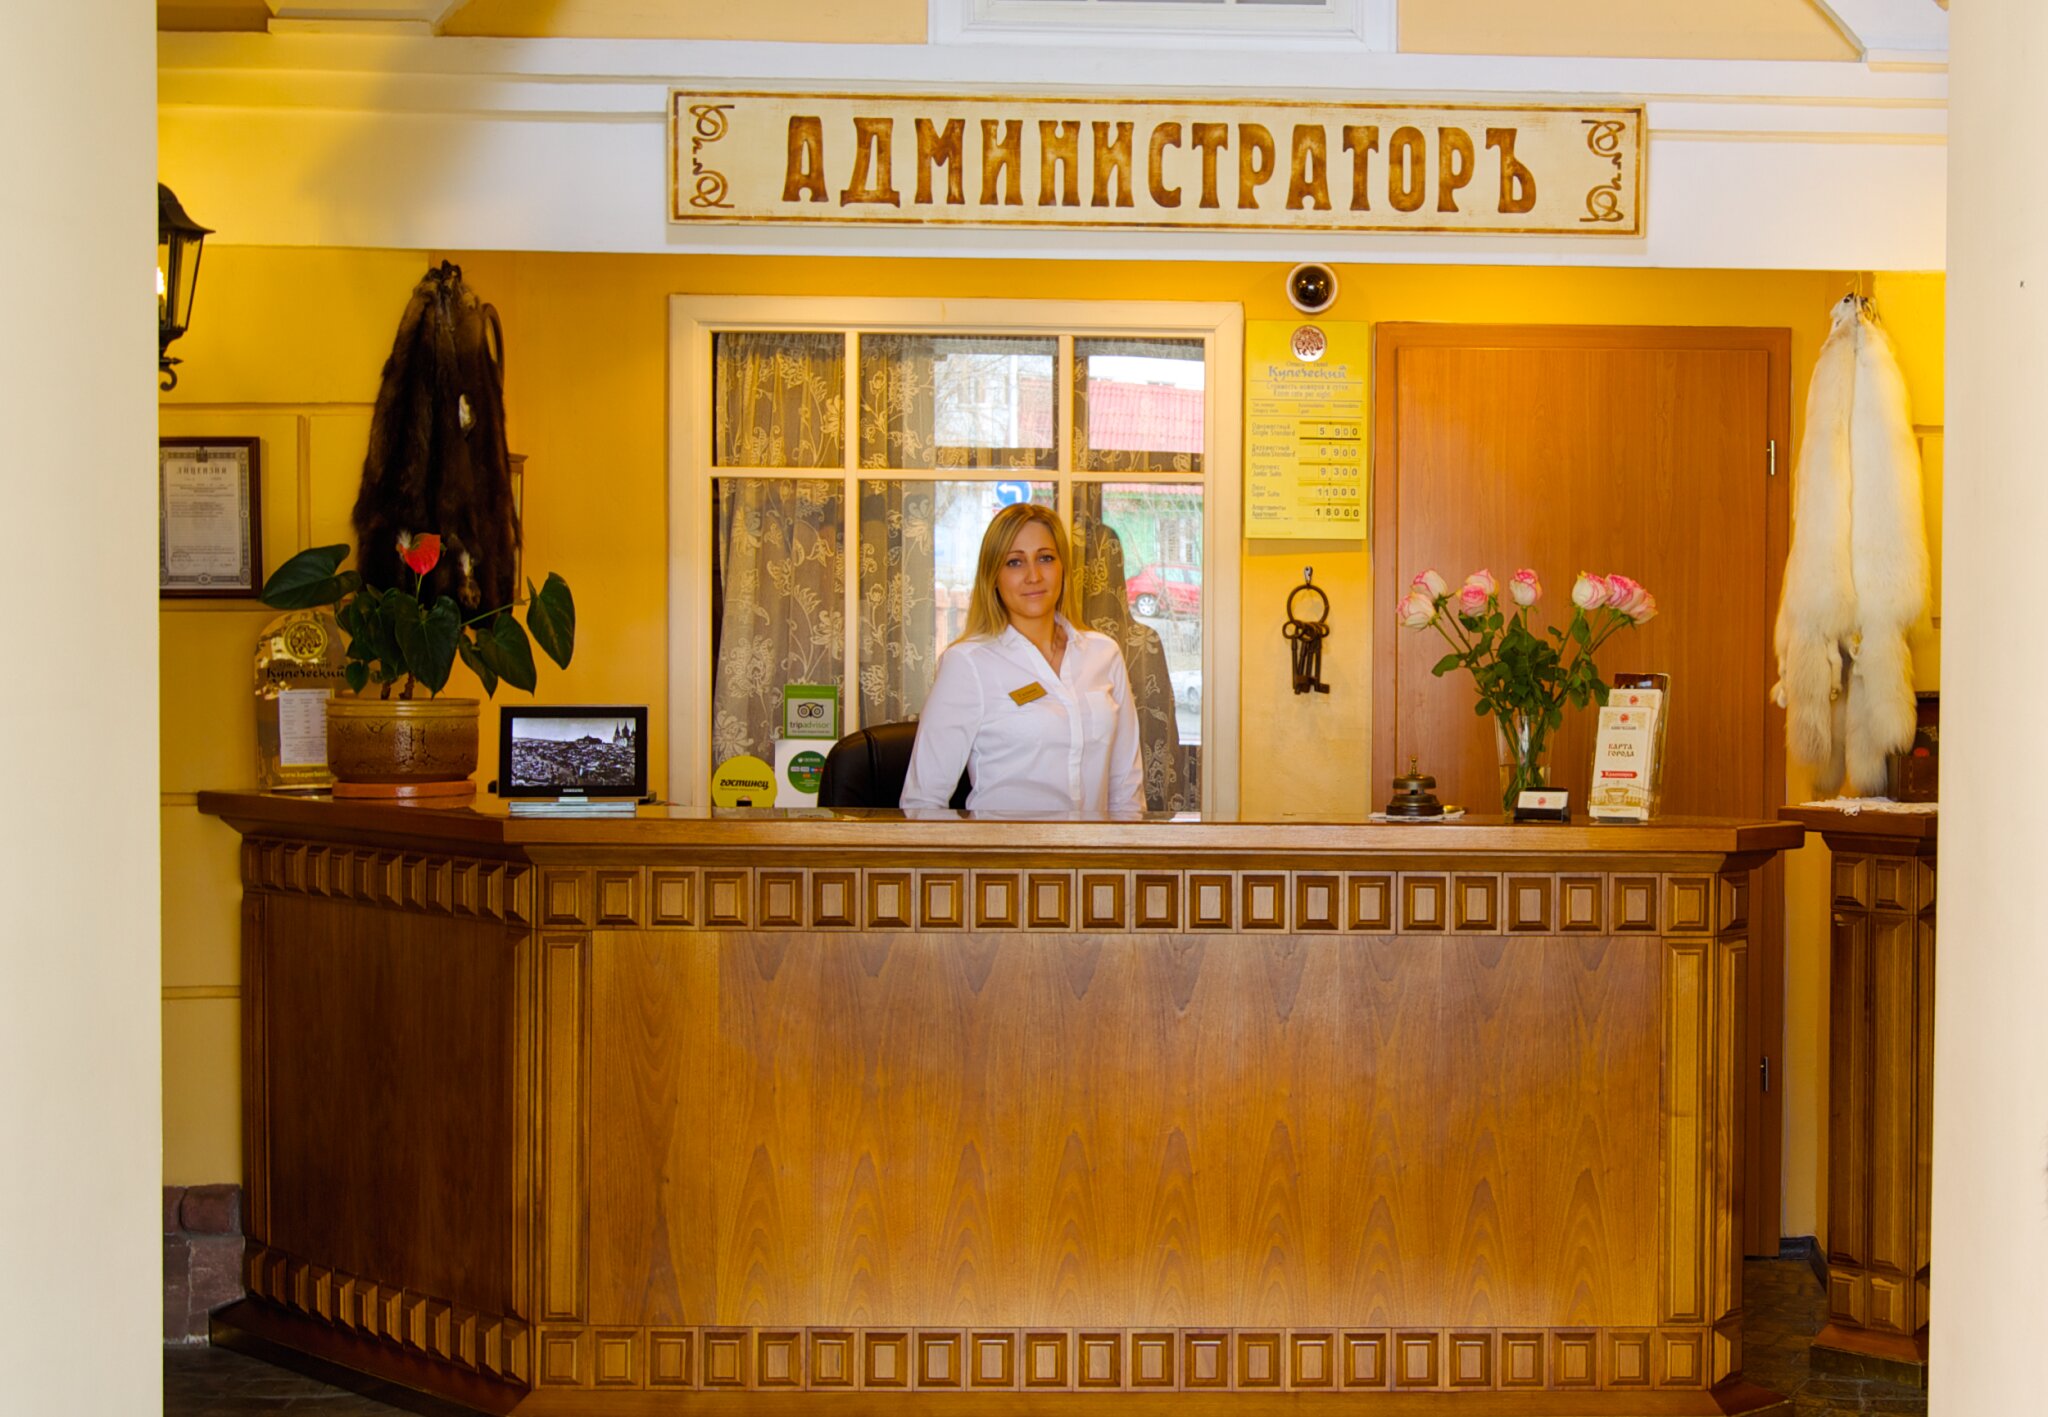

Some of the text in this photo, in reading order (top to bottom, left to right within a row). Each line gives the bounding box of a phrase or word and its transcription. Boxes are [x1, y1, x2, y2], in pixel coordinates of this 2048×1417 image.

[781, 116, 1537, 213] АДМИНИСТРАТОРЪ
[1268, 364, 1347, 382] Купеческий
[789, 720, 830, 730] tripadvisor
[720, 778, 769, 790] гостинец
